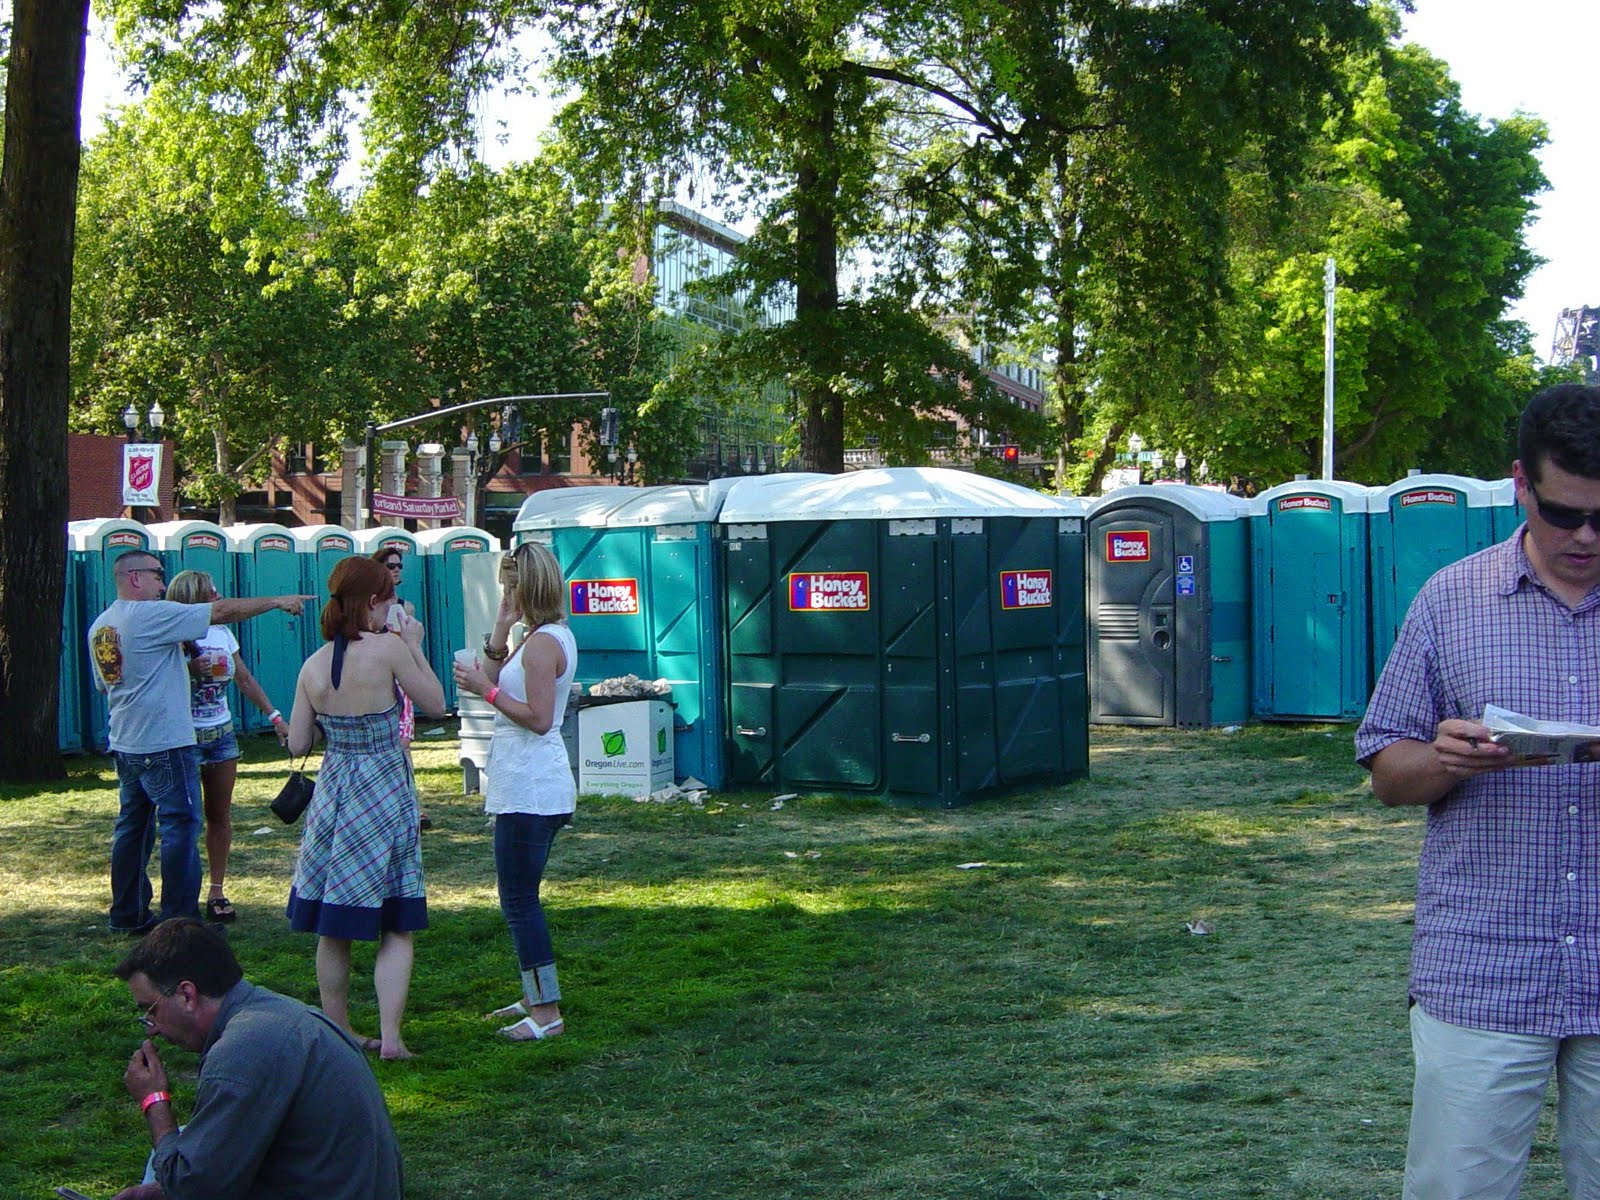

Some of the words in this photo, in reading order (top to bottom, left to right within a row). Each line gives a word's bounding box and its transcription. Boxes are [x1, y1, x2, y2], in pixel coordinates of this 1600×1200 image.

[374, 499, 402, 511] ortland
[402, 501, 434, 516] Saturday
[1113, 538, 1144, 550] Honey
[1114, 547, 1147, 557] Bucket
[587, 582, 631, 600] Honey
[810, 575, 861, 595] Honey
[1016, 573, 1048, 592] Honey
[588, 596, 637, 612] Bucket
[810, 591, 867, 608] Bucket
[1018, 588, 1051, 605] Bucket
[585, 759, 645, 769] OregonLive.com
